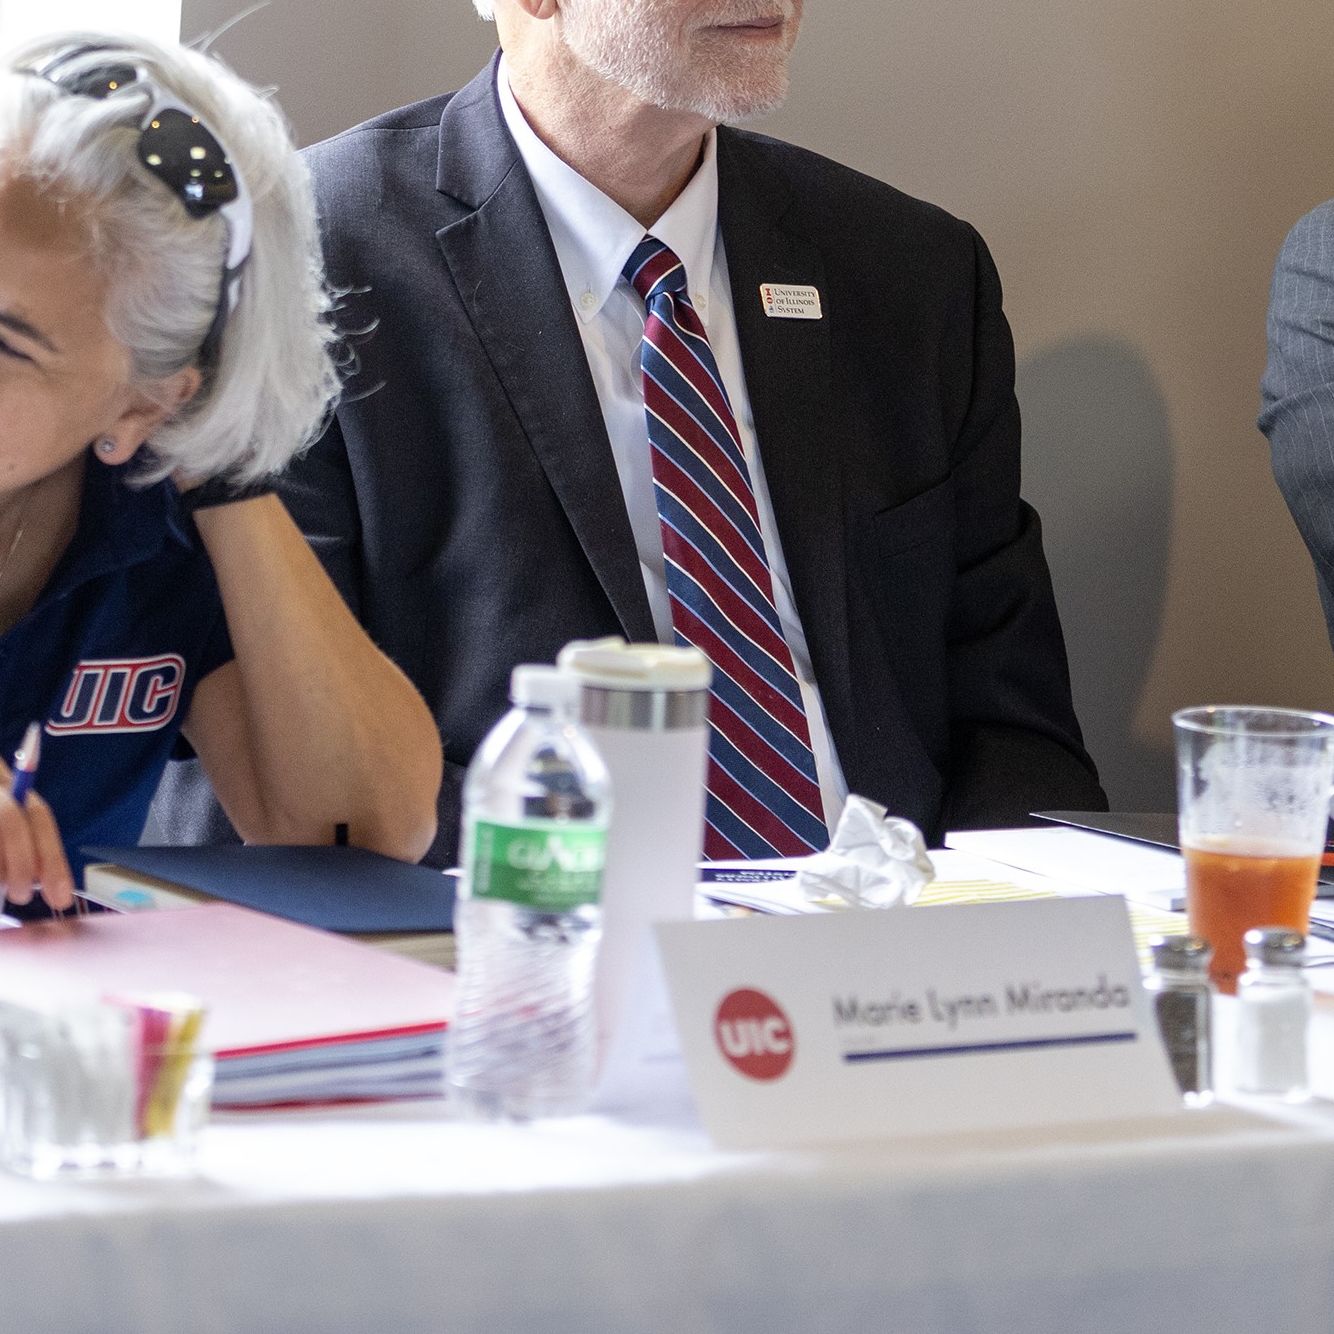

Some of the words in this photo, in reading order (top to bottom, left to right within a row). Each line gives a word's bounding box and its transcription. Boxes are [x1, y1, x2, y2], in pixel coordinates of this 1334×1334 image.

[774, 288, 816, 298] UNIVERSITY
[786, 297, 815, 306] ILLINOIS
[777, 305, 805, 314] SYSTEM
[832, 992, 922, 1027] Marie
[926, 986, 999, 1030] Lynn
[1005, 974, 1131, 1016] Miranda
[720, 1016, 792, 1059] UIC
